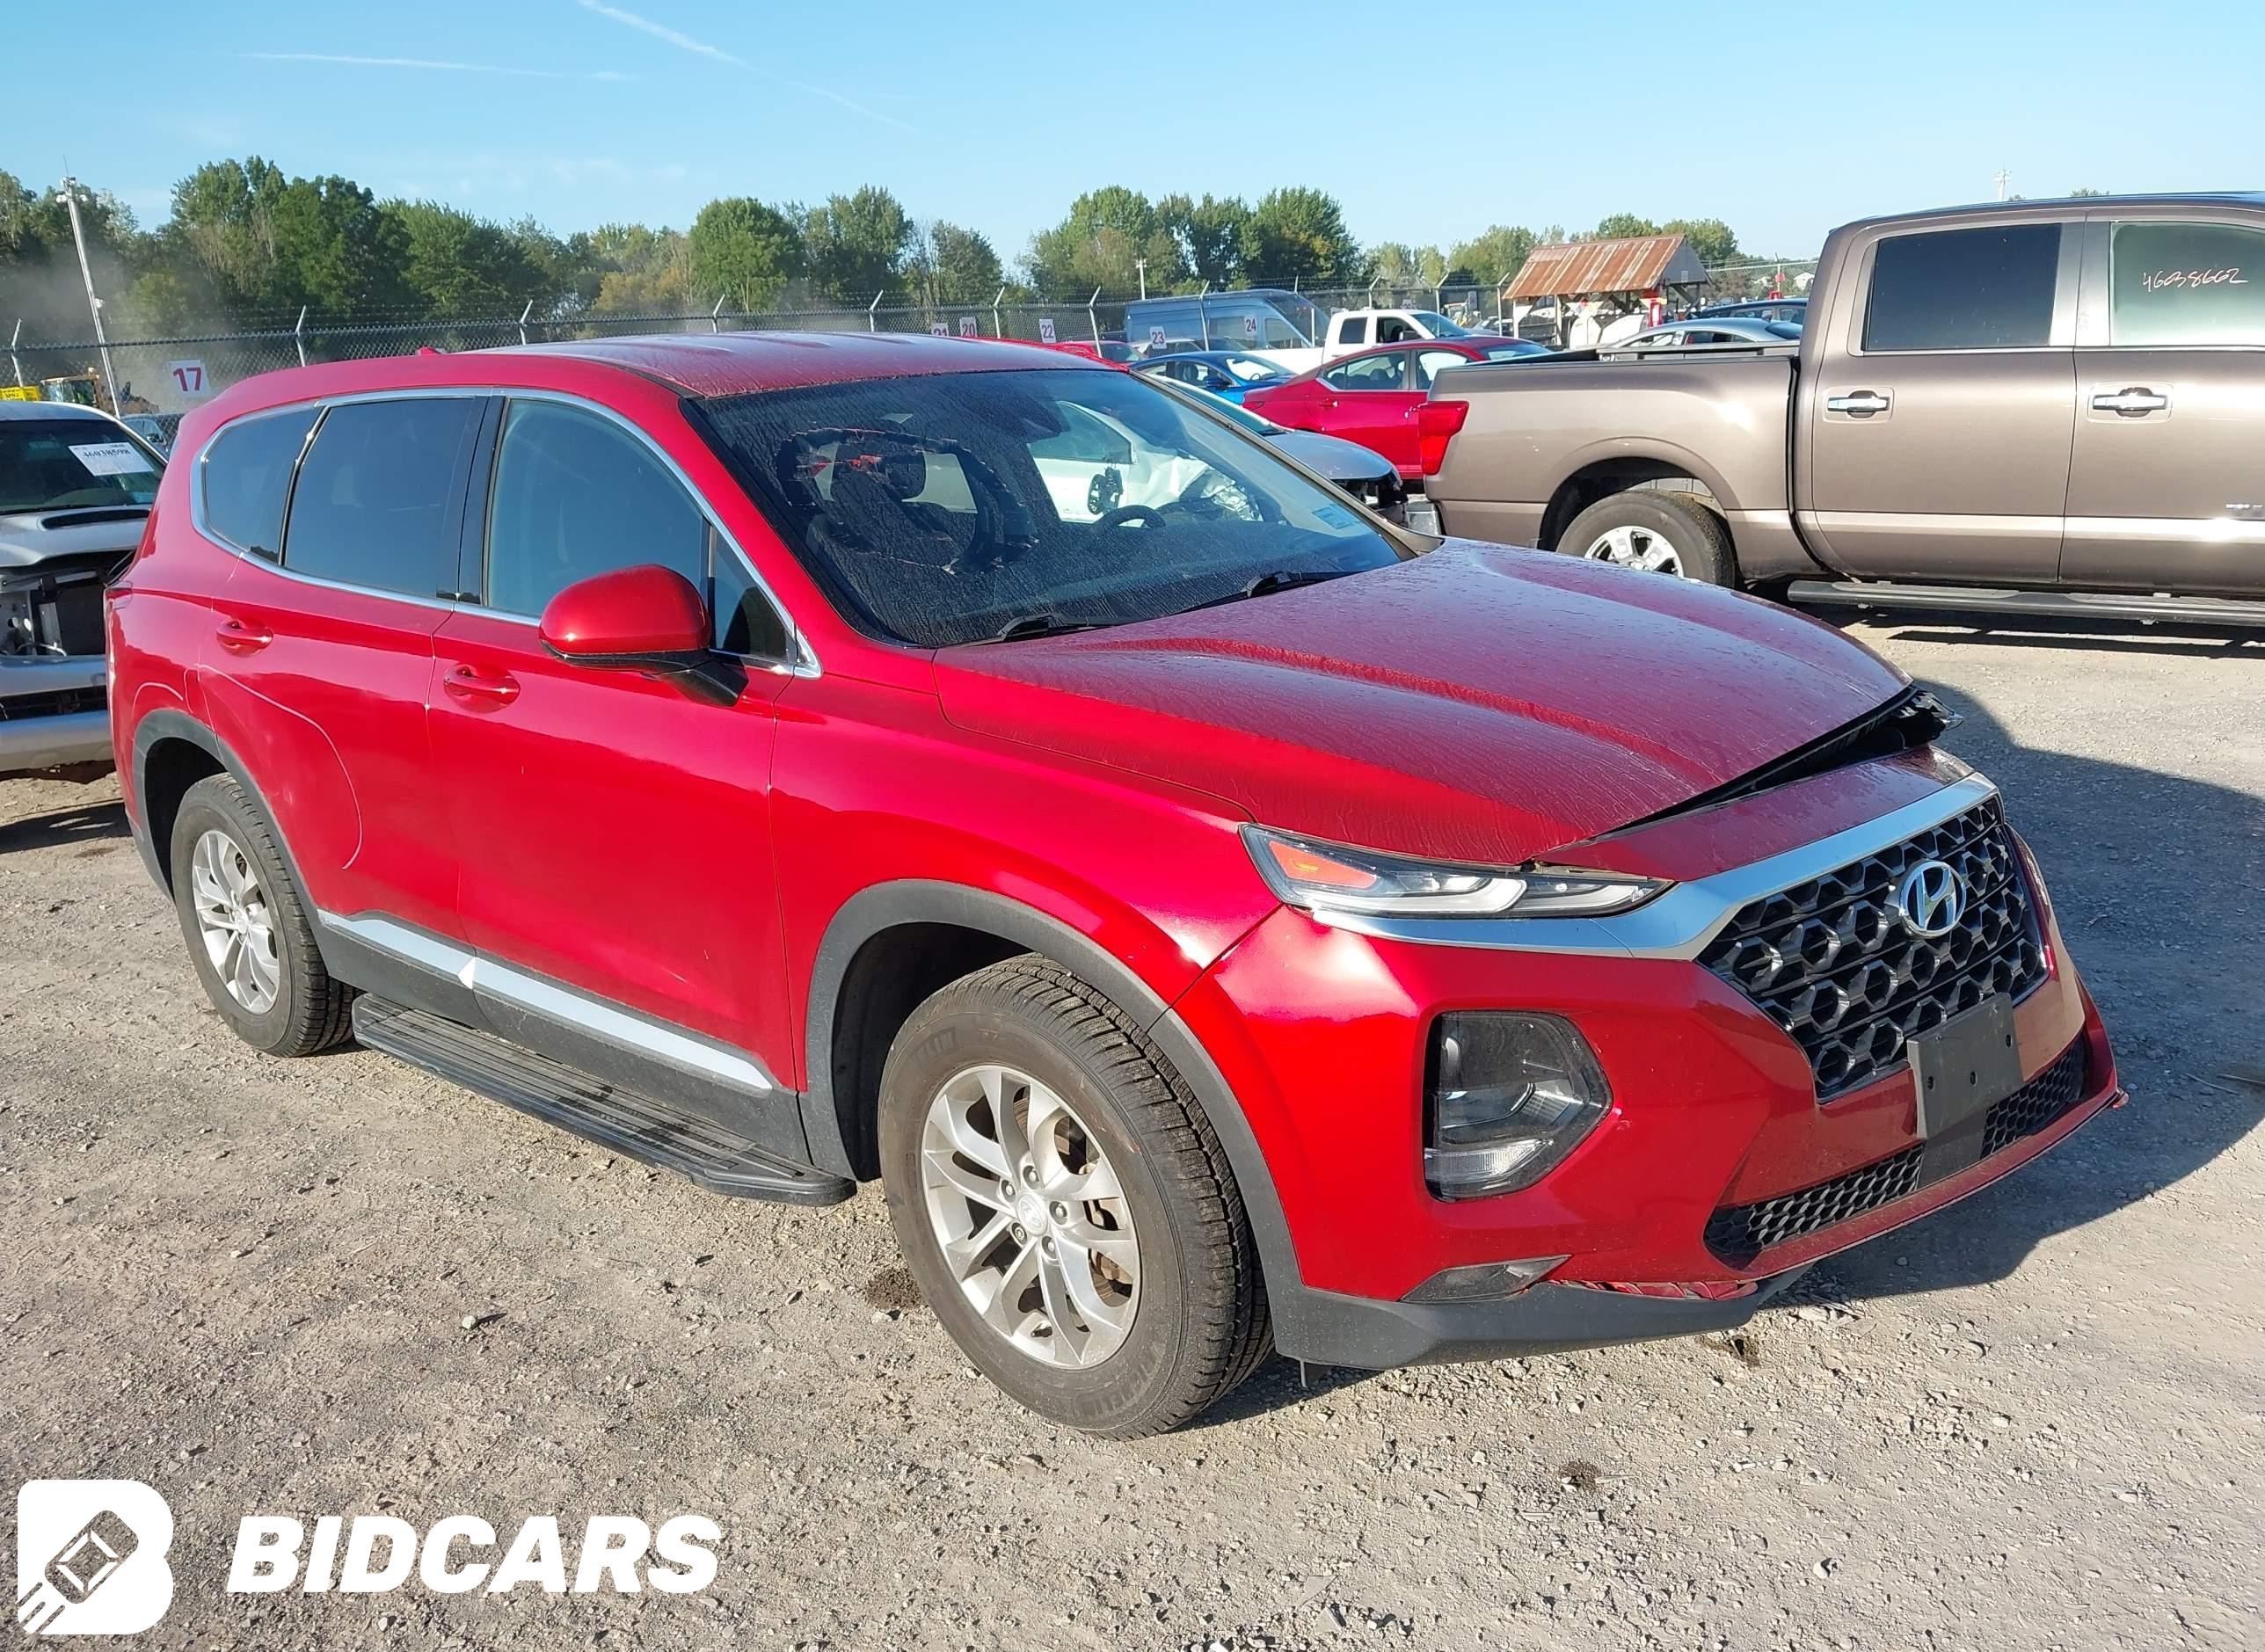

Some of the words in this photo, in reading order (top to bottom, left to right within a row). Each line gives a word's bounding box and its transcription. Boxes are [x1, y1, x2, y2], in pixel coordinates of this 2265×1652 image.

[962, 324, 975, 338] 20
[1042, 324, 1054, 338] 22
[1245, 318, 1256, 332] 24
[1151, 331, 1164, 345] 23
[172, 367, 201, 391] 17
